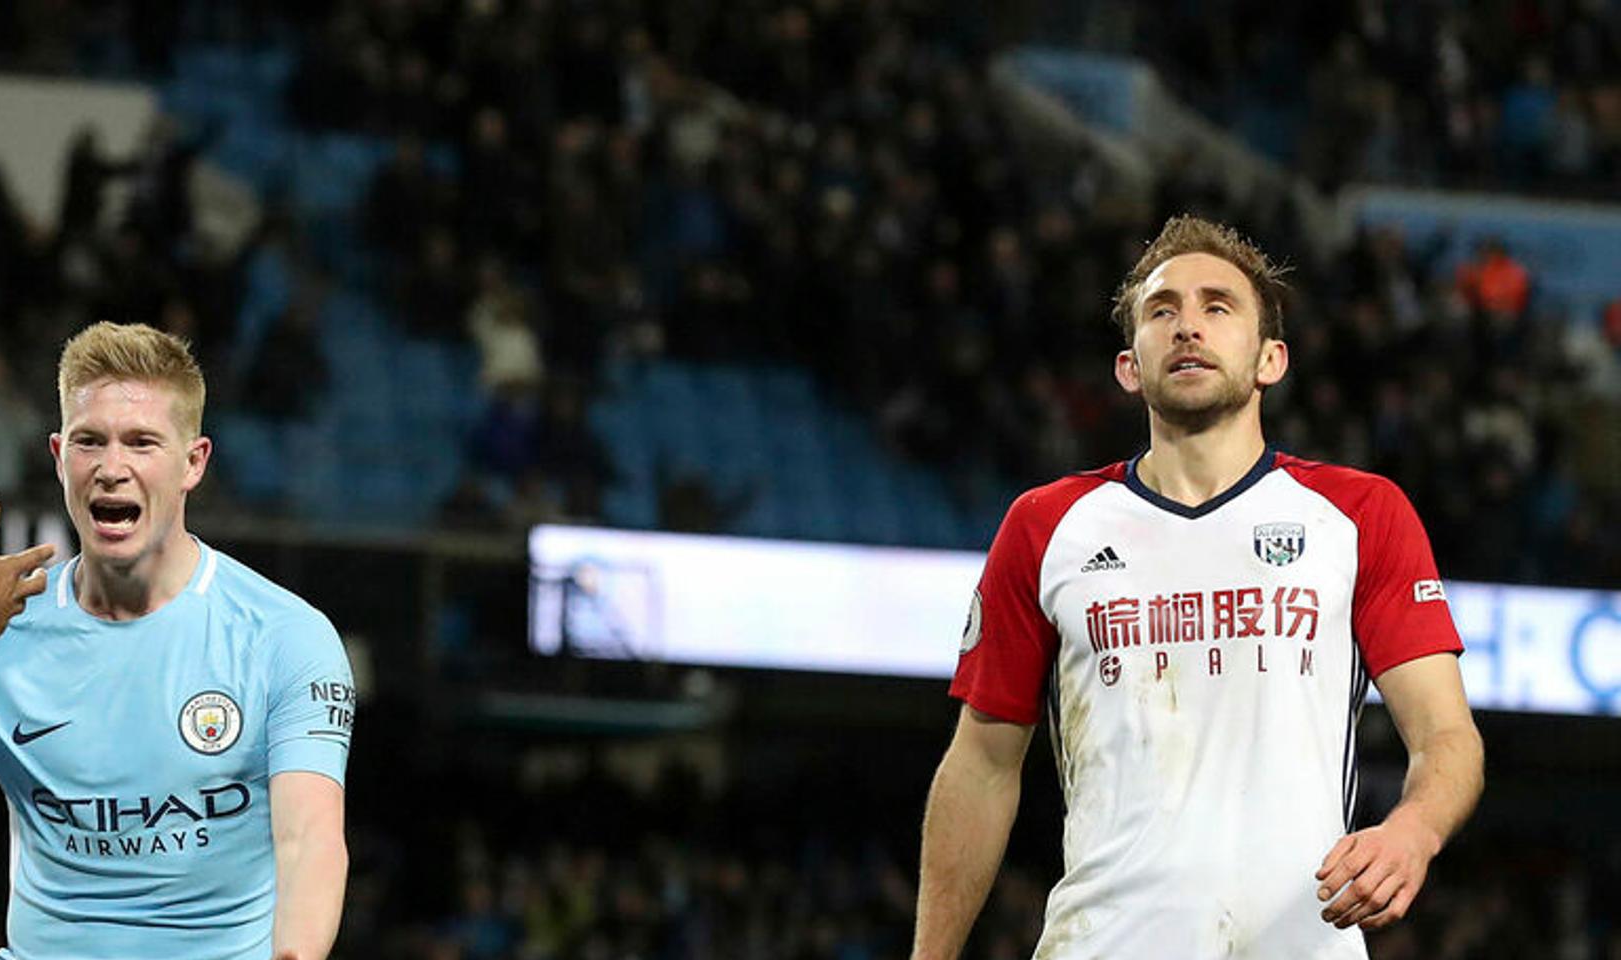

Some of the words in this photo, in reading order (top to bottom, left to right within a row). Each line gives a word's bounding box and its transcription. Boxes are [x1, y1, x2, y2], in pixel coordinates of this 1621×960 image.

[1085, 586, 1321, 654] 棕榈股份
[31, 782, 252, 832] ETIHAD
[65, 827, 211, 857] AIRWAYS
